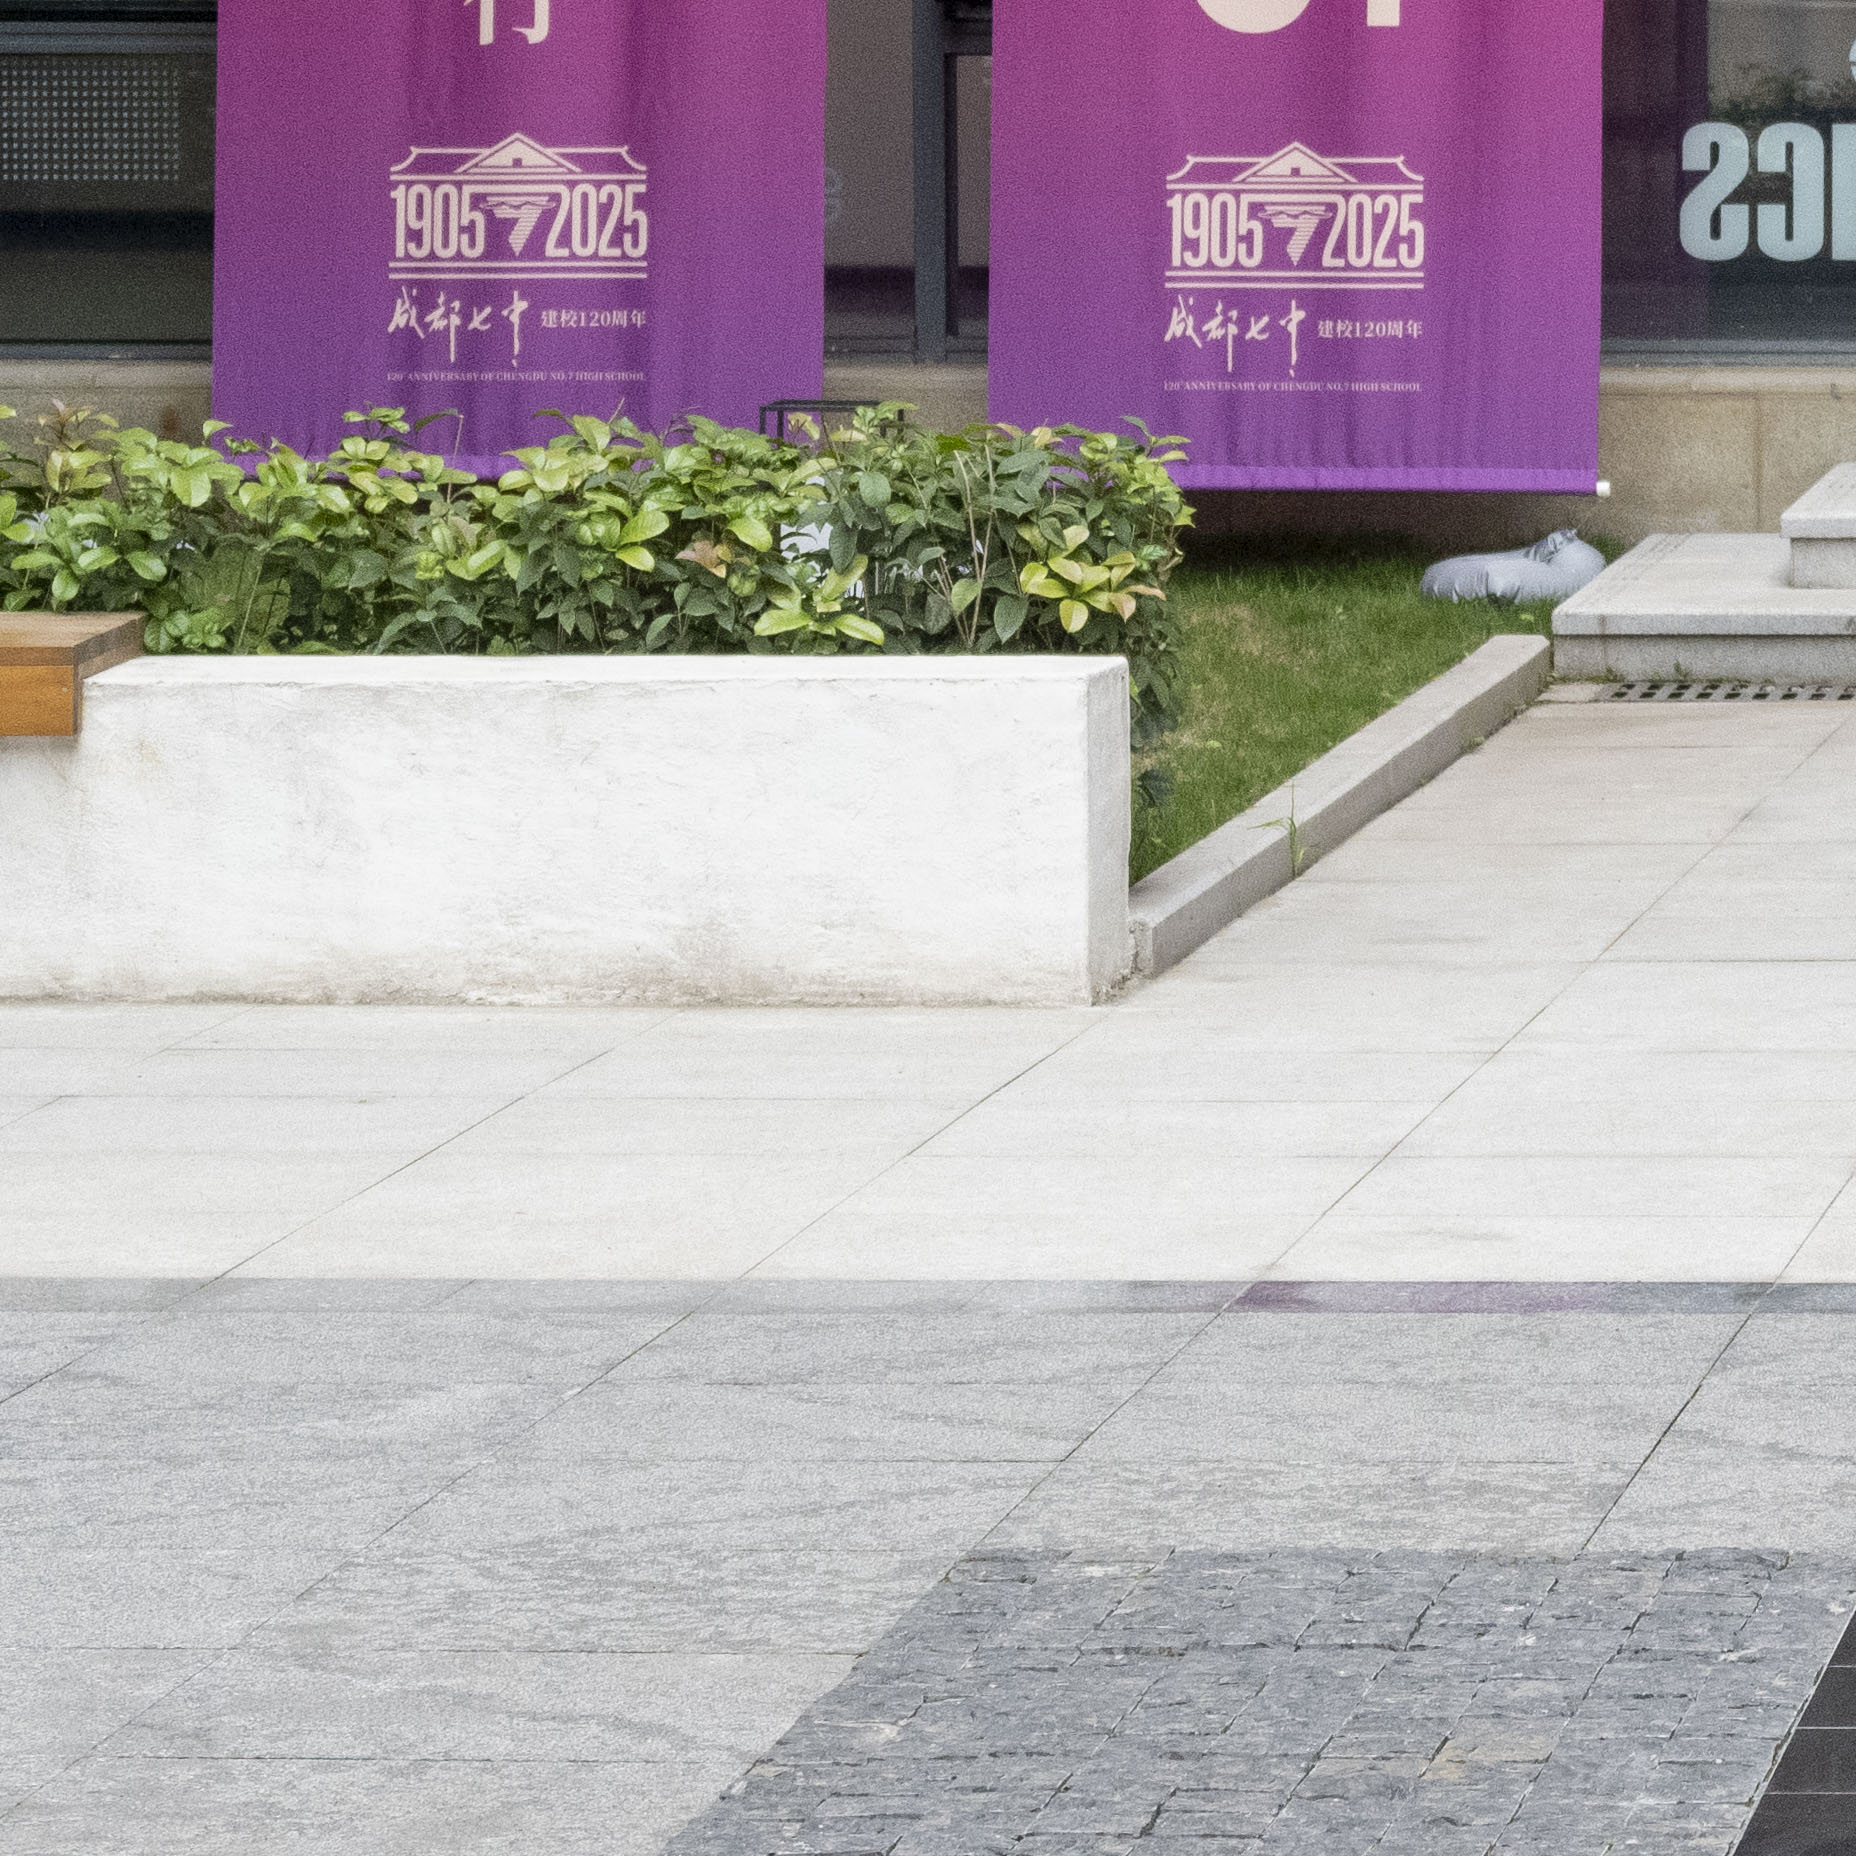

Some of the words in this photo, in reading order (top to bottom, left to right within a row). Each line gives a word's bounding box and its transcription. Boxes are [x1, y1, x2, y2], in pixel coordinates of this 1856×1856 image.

[390, 184, 486, 258] 1905
[545, 184, 648, 258] 2025
[1166, 194, 1264, 268] 1905
[1321, 194, 1425, 268] 2025
[541, 309, 647, 329] 建校120周年
[1317, 319, 1423, 339] 建校120周年
